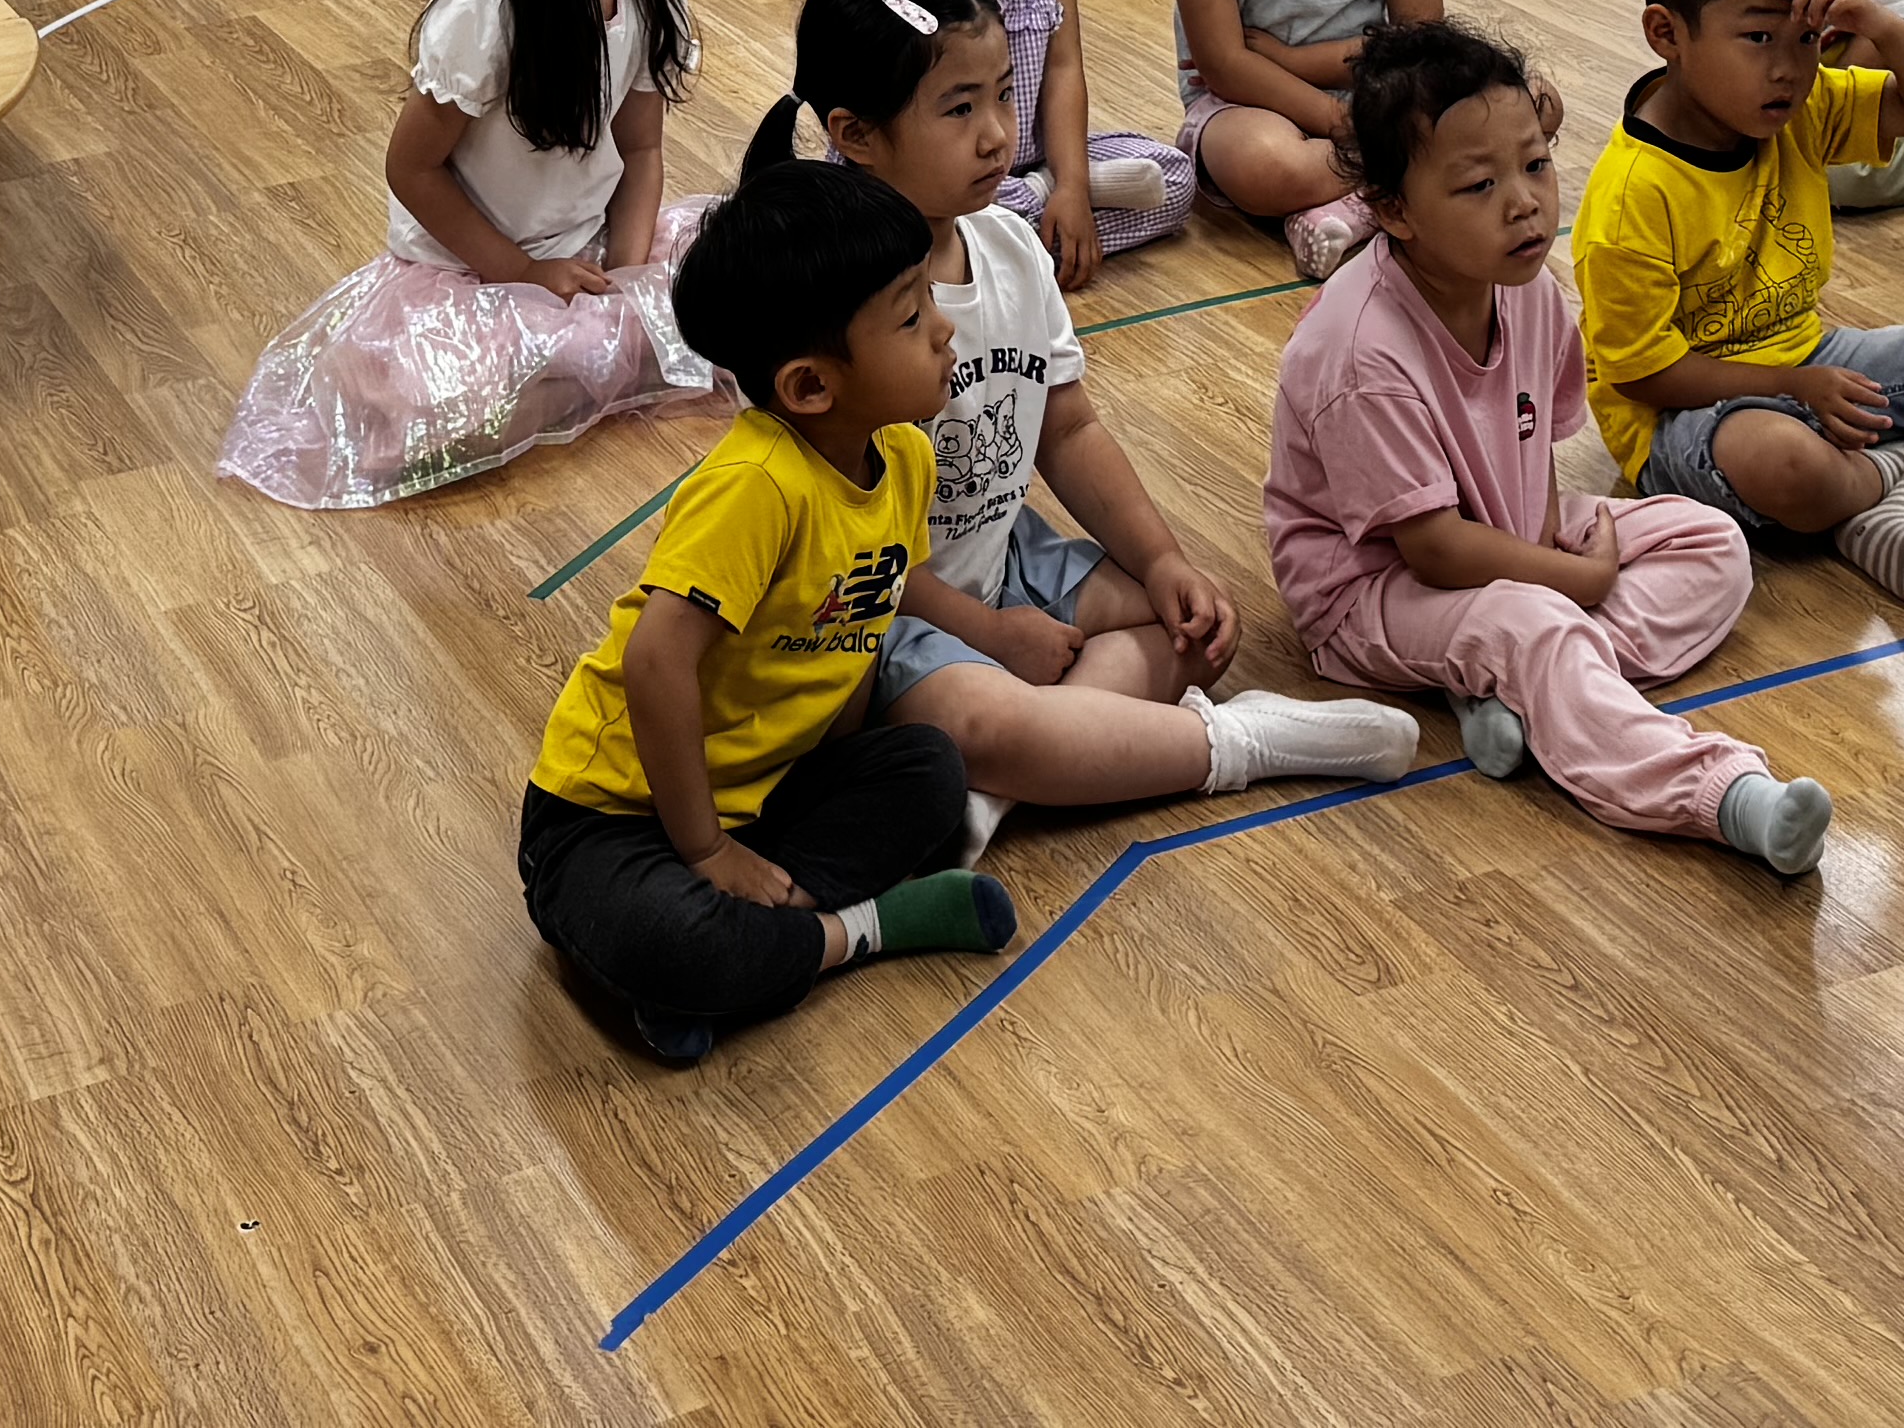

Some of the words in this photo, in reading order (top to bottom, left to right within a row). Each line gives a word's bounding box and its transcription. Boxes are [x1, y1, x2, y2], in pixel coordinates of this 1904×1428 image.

[950, 356, 986, 400] RGI
[770, 634, 827, 653] new
[824, 625, 886, 654] bala
